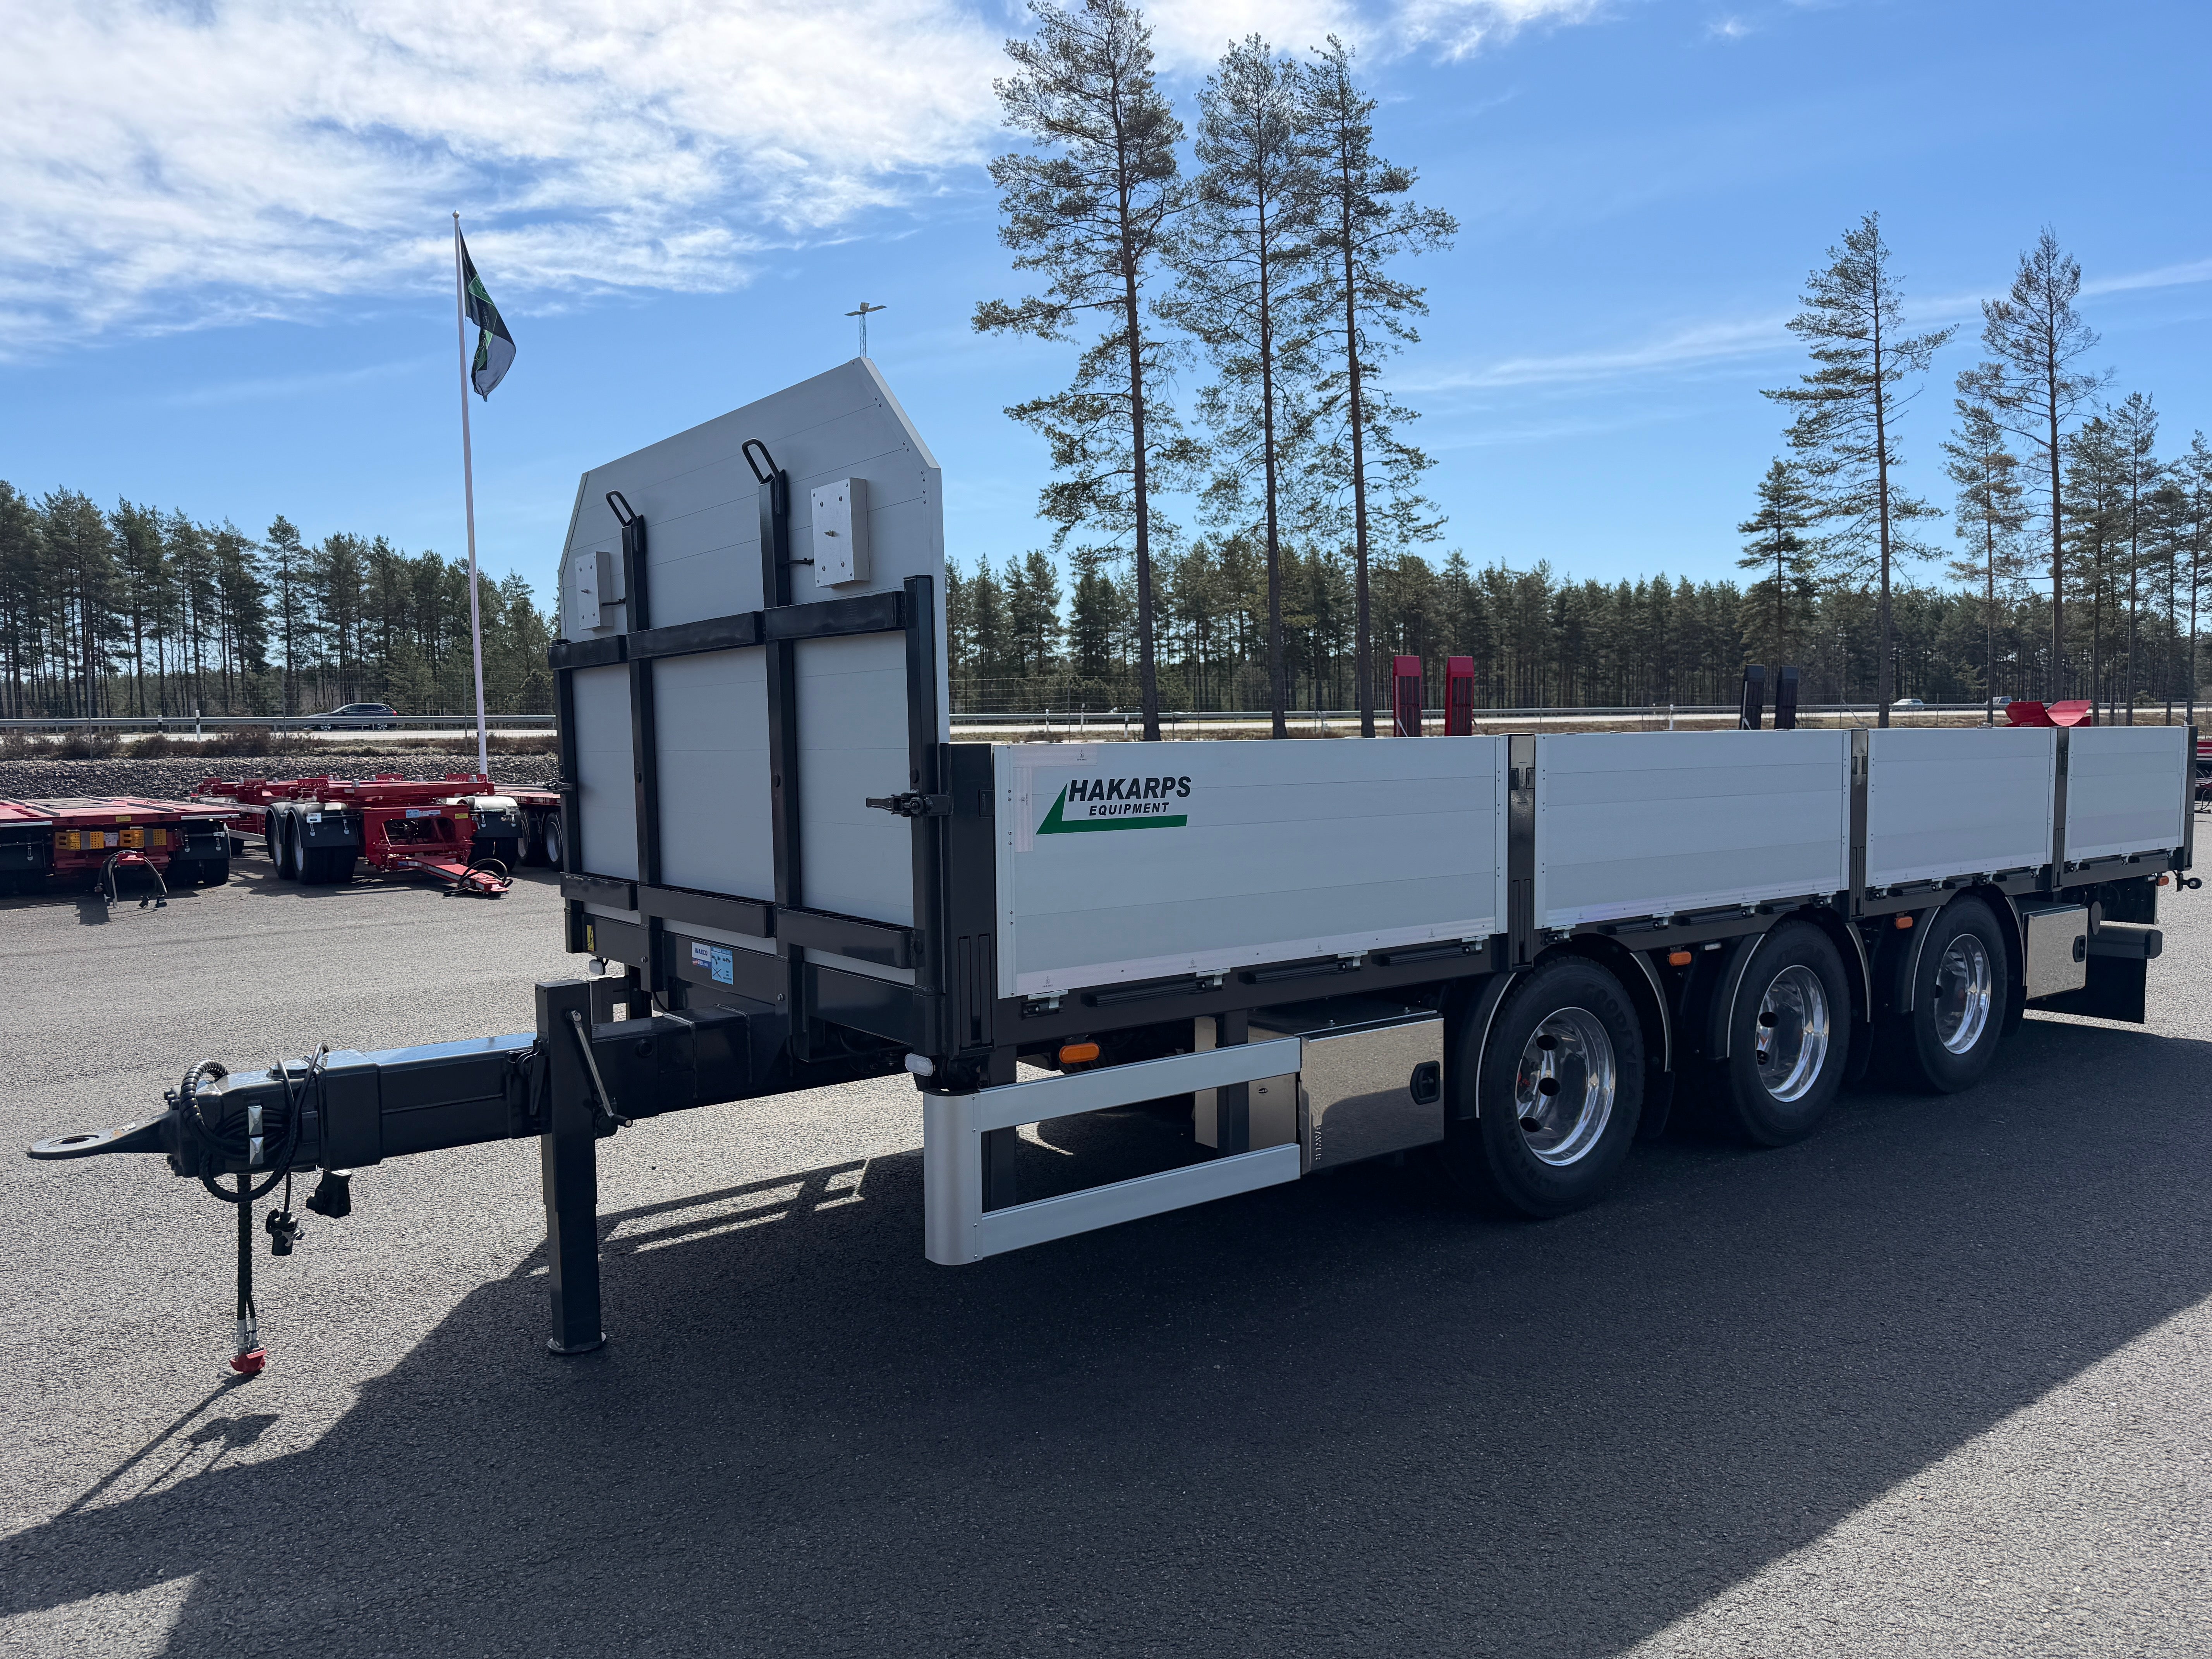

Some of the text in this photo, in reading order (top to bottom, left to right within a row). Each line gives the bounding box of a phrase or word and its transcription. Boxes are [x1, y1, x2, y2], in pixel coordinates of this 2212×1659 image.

[1068, 776, 1192, 802] HAKARPS
[1089, 802, 1170, 816] EQUIPMENT
[695, 948, 708, 956] WABCO
